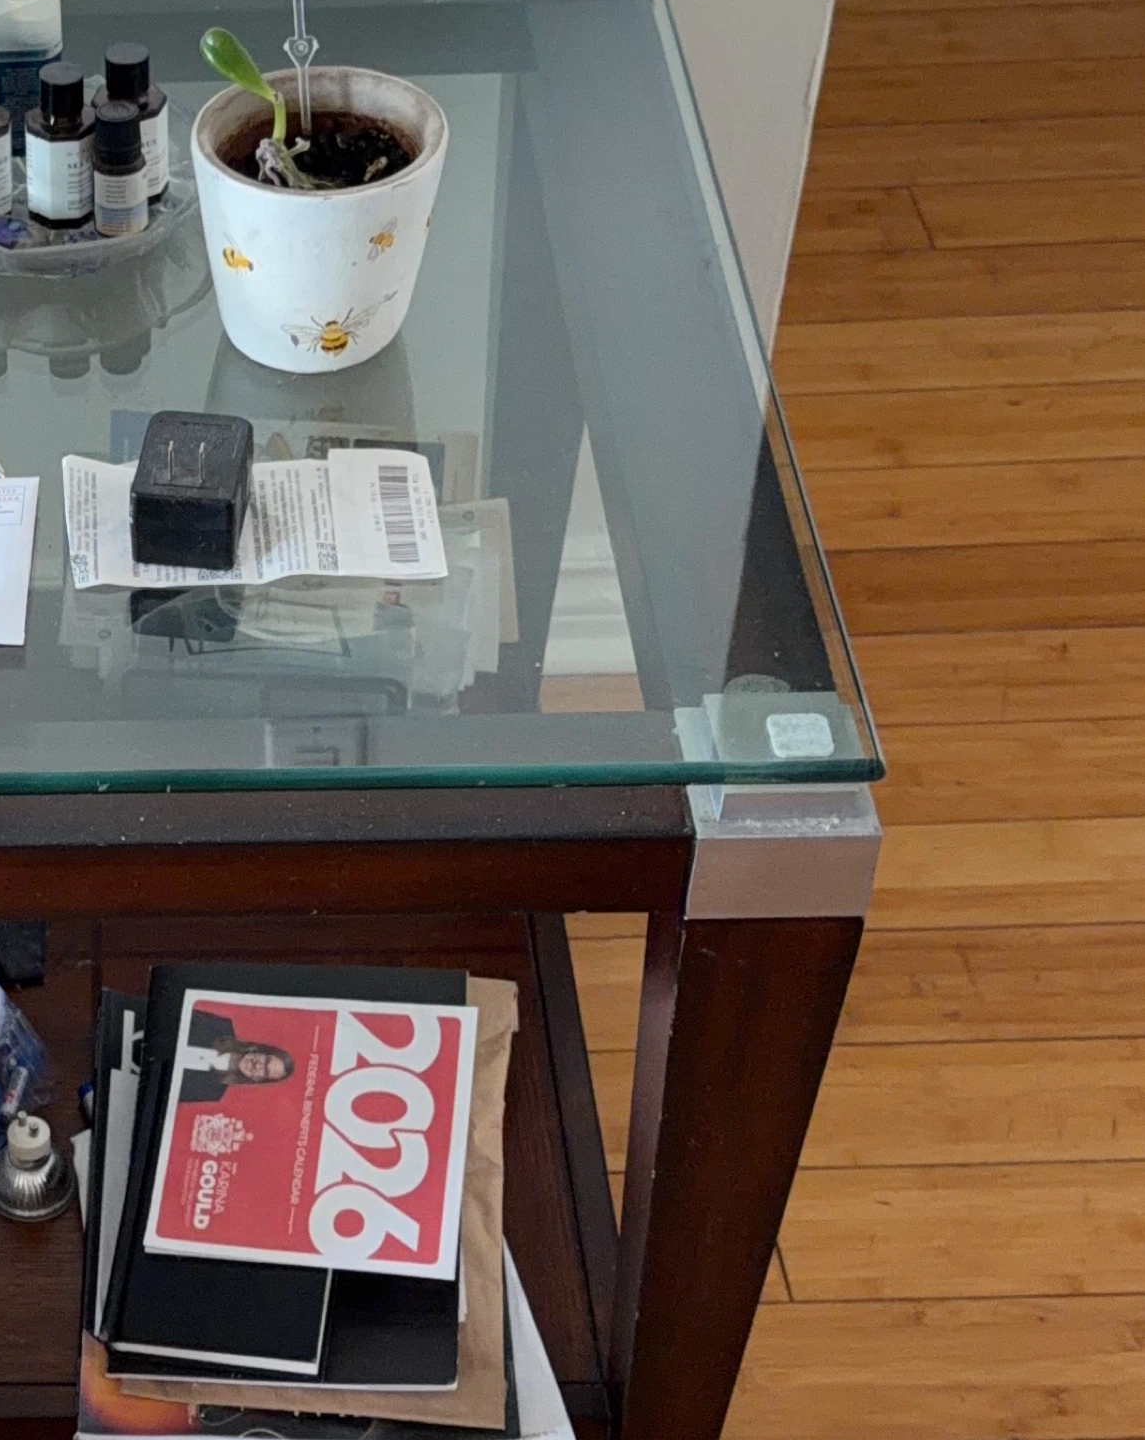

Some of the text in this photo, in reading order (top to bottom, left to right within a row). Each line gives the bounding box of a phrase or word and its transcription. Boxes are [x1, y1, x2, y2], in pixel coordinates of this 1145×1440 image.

[289, 1053, 319, 1205] FEDERAL BENEFITS CALENDAR
[308, 1008, 442, 1262] 2026
[193, 1160, 218, 1230] GOULD
[213, 1161, 232, 1214] KARINA
